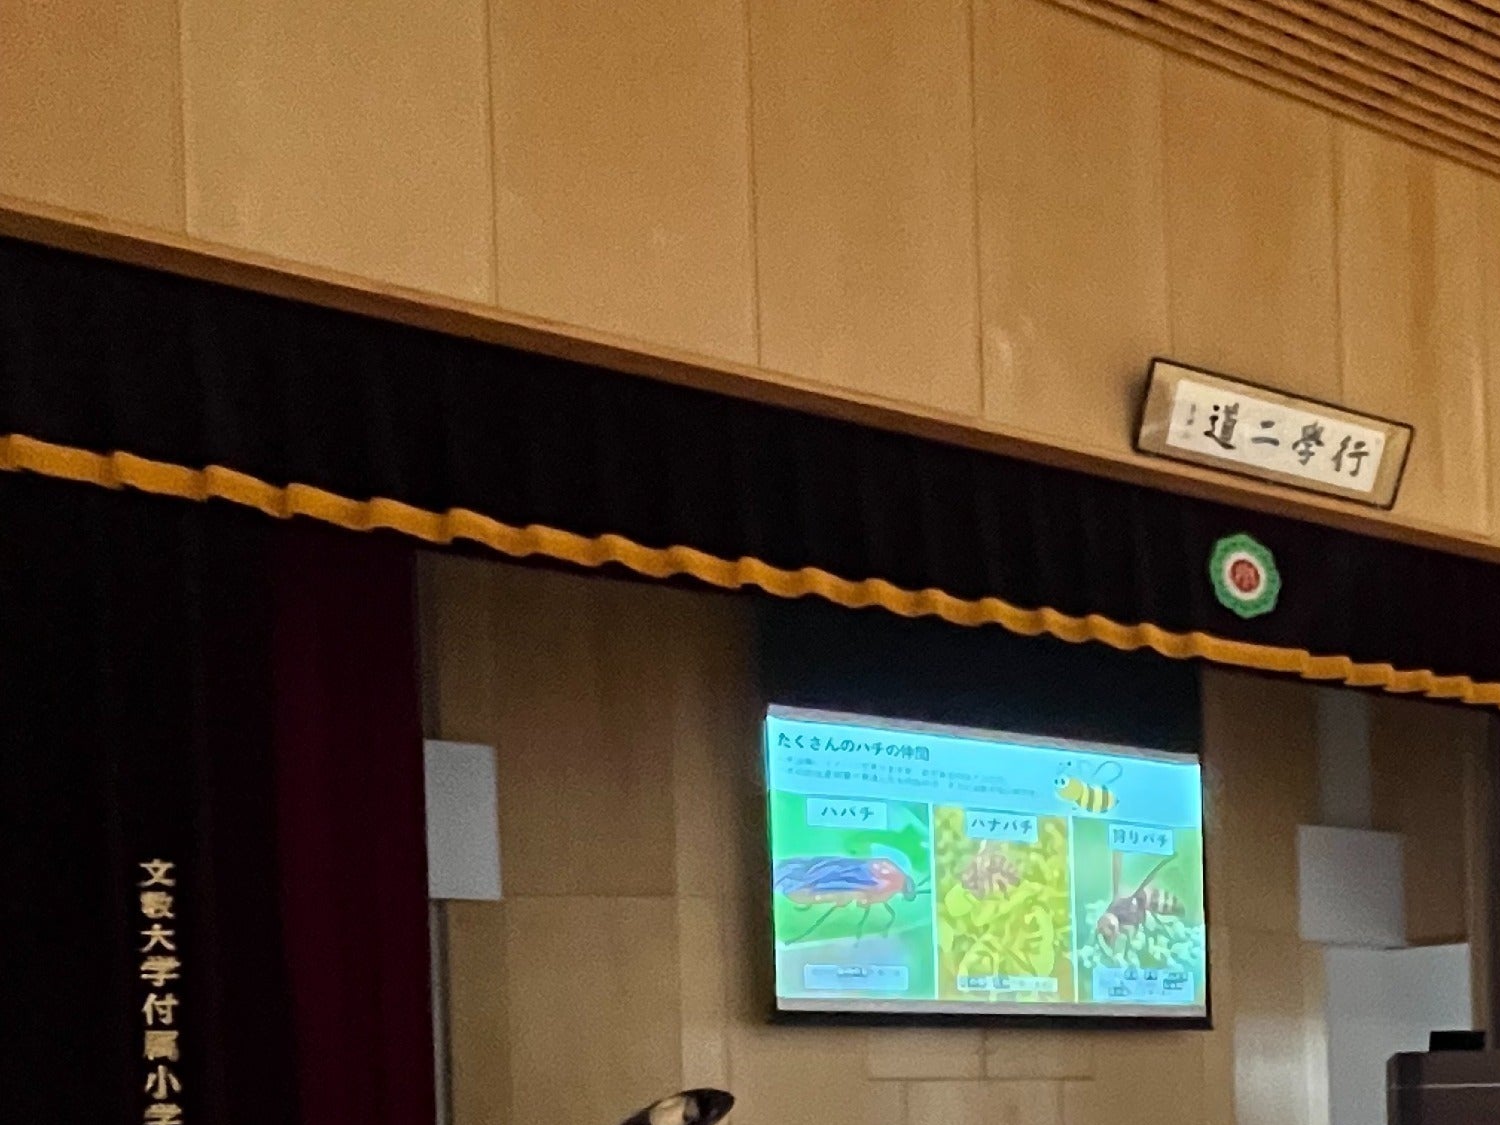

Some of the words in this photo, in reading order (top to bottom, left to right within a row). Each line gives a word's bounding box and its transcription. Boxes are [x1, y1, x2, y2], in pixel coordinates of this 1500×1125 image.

[777, 732, 930, 762] たくさんのハチの仲間
[820, 805, 875, 822] ハバチ
[970, 817, 1034, 835] ハナバチ
